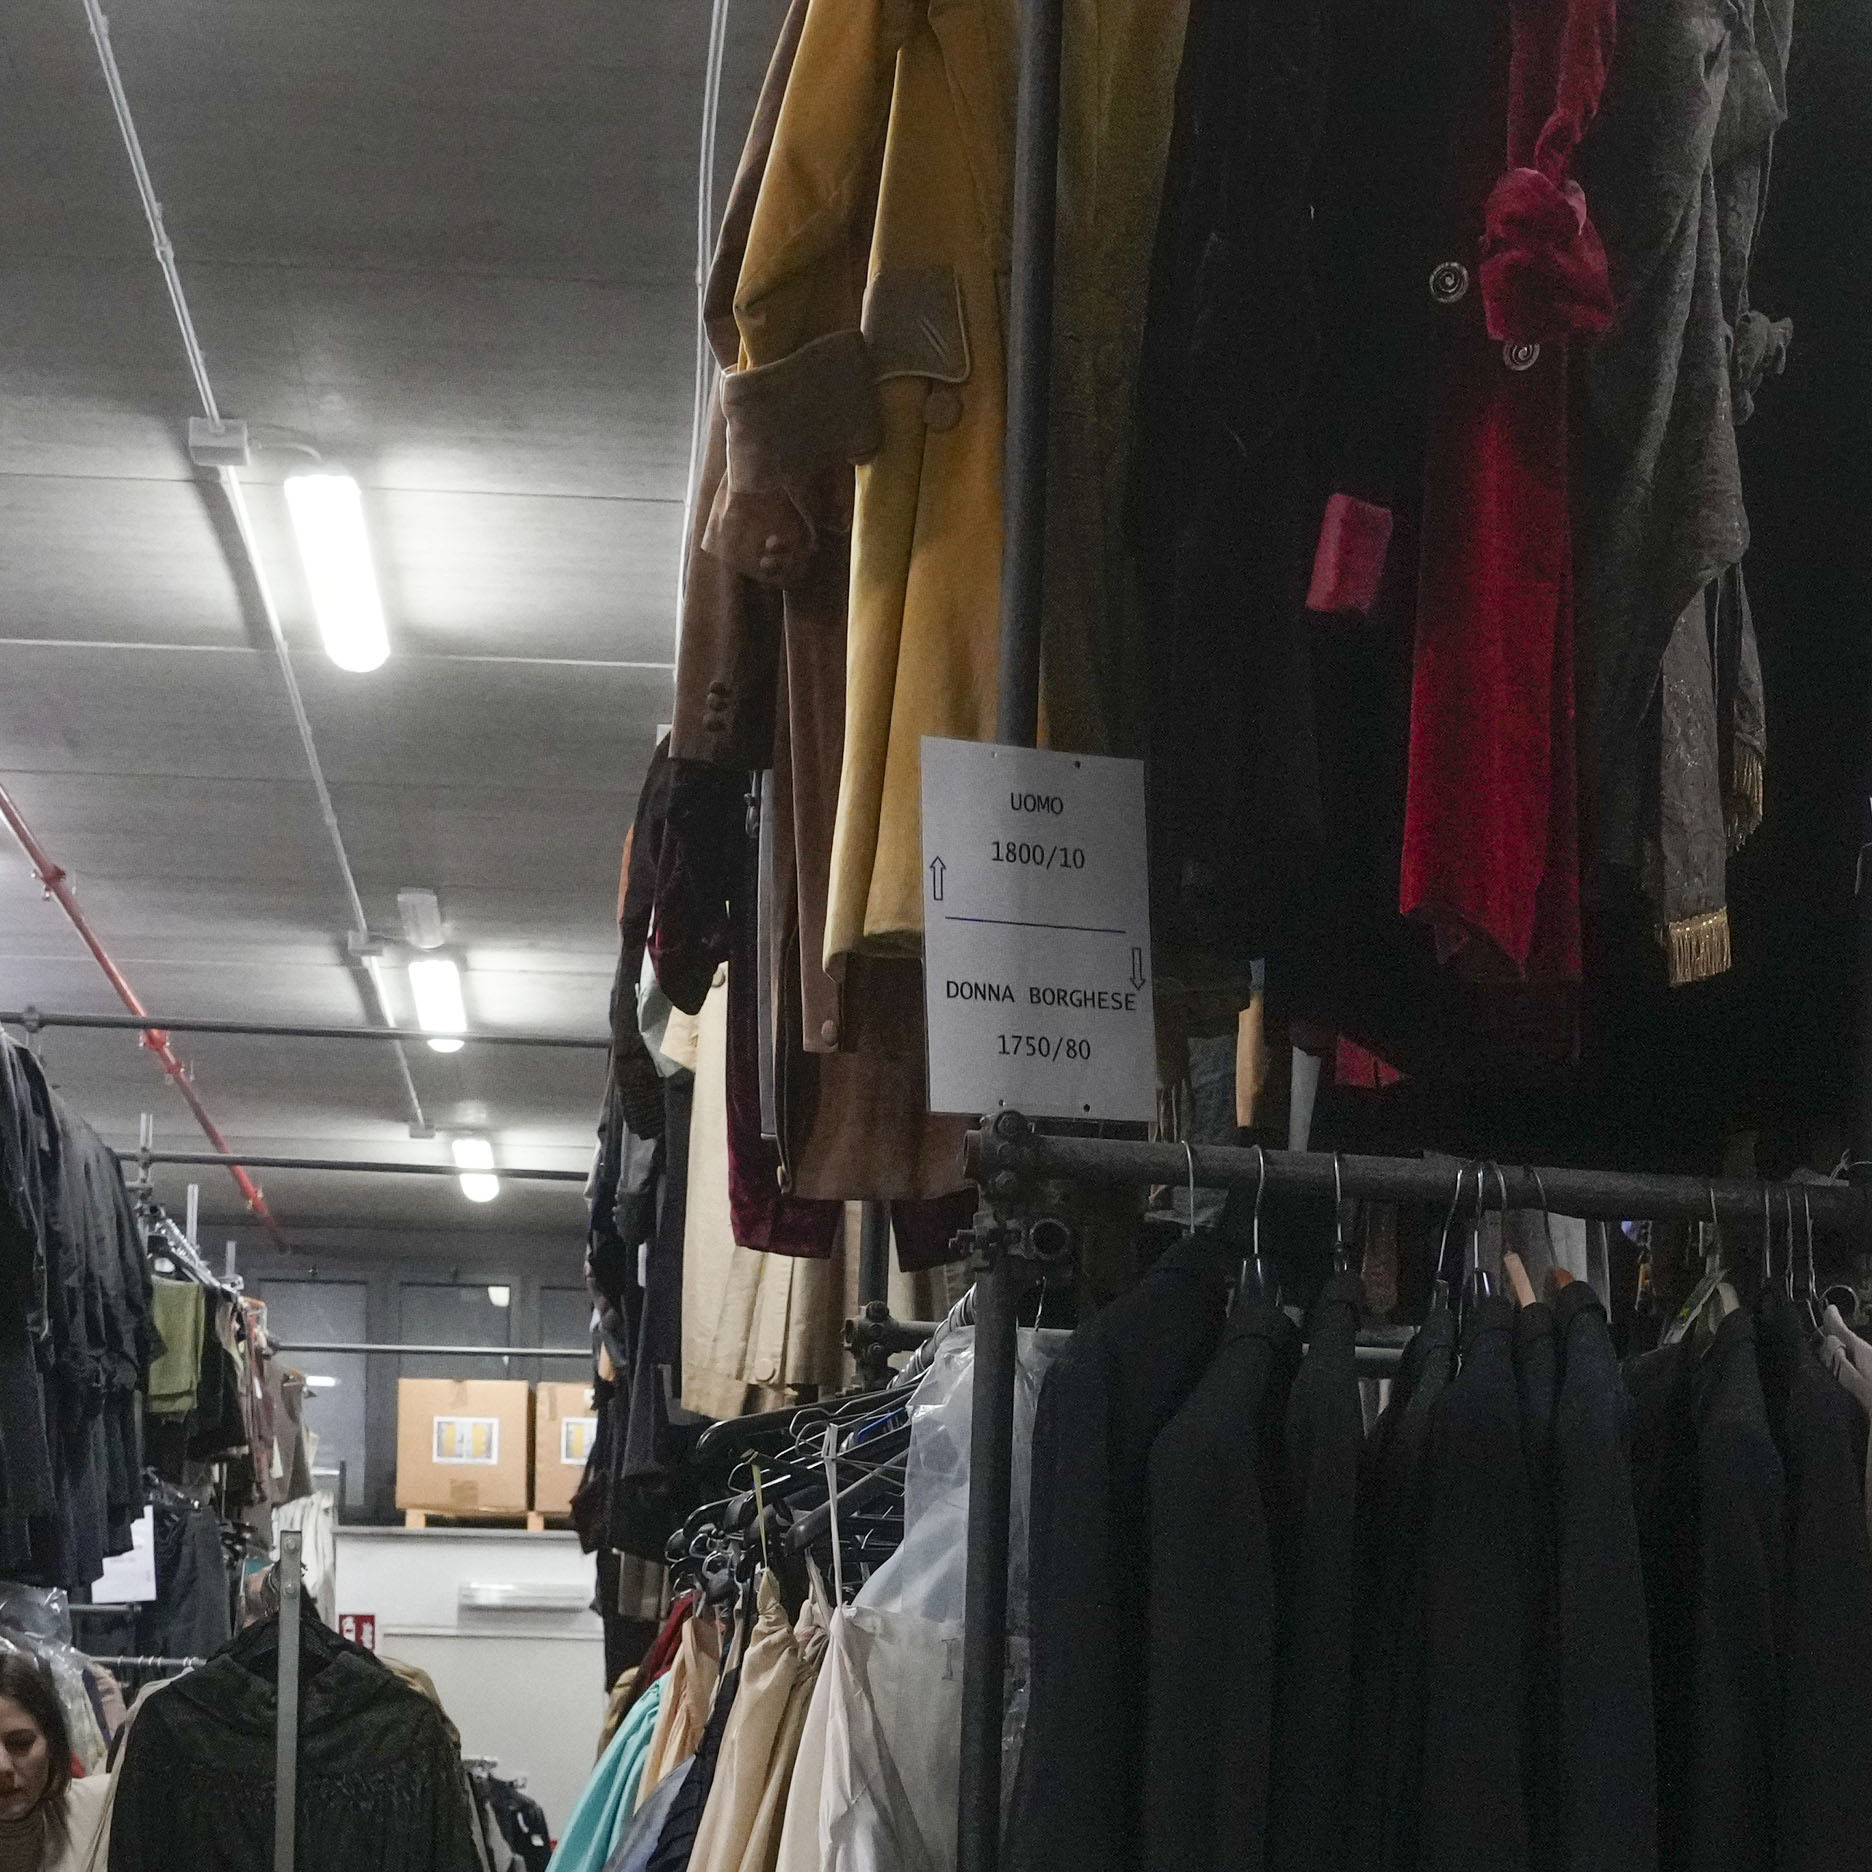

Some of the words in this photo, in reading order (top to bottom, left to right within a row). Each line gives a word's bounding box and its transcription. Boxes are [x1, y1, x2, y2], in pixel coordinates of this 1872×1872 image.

[1010, 792, 1064, 815] UOMO
[991, 841, 1085, 870] 1800/10
[946, 981, 1015, 1003] DONNA
[1029, 987, 1137, 1012] BORGHESE
[997, 1035, 1091, 1061] 1750/80
